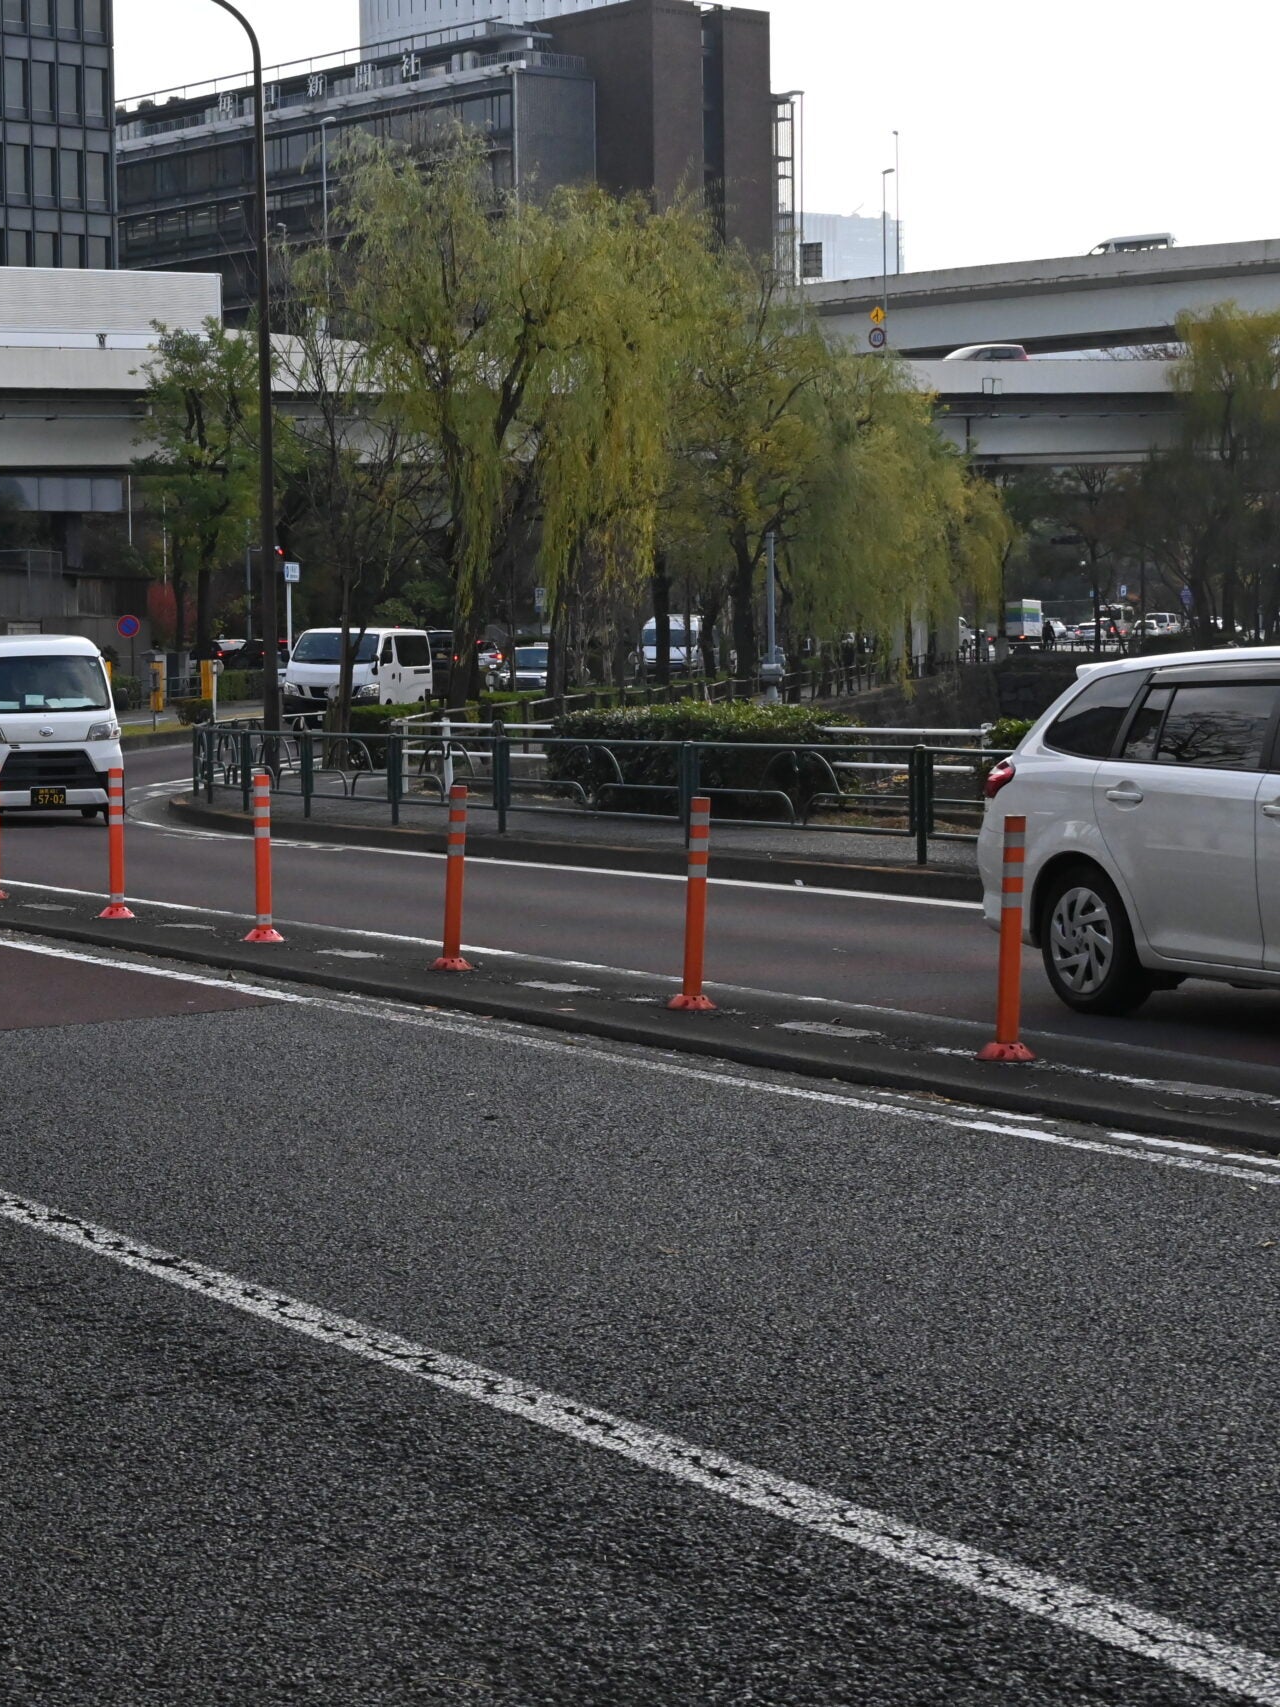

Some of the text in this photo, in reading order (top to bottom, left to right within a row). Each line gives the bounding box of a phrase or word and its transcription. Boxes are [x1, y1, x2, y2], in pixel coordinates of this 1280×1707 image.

[218, 54, 420, 112] 毎日新聞社
[38, 794, 65, 804] 57-02
